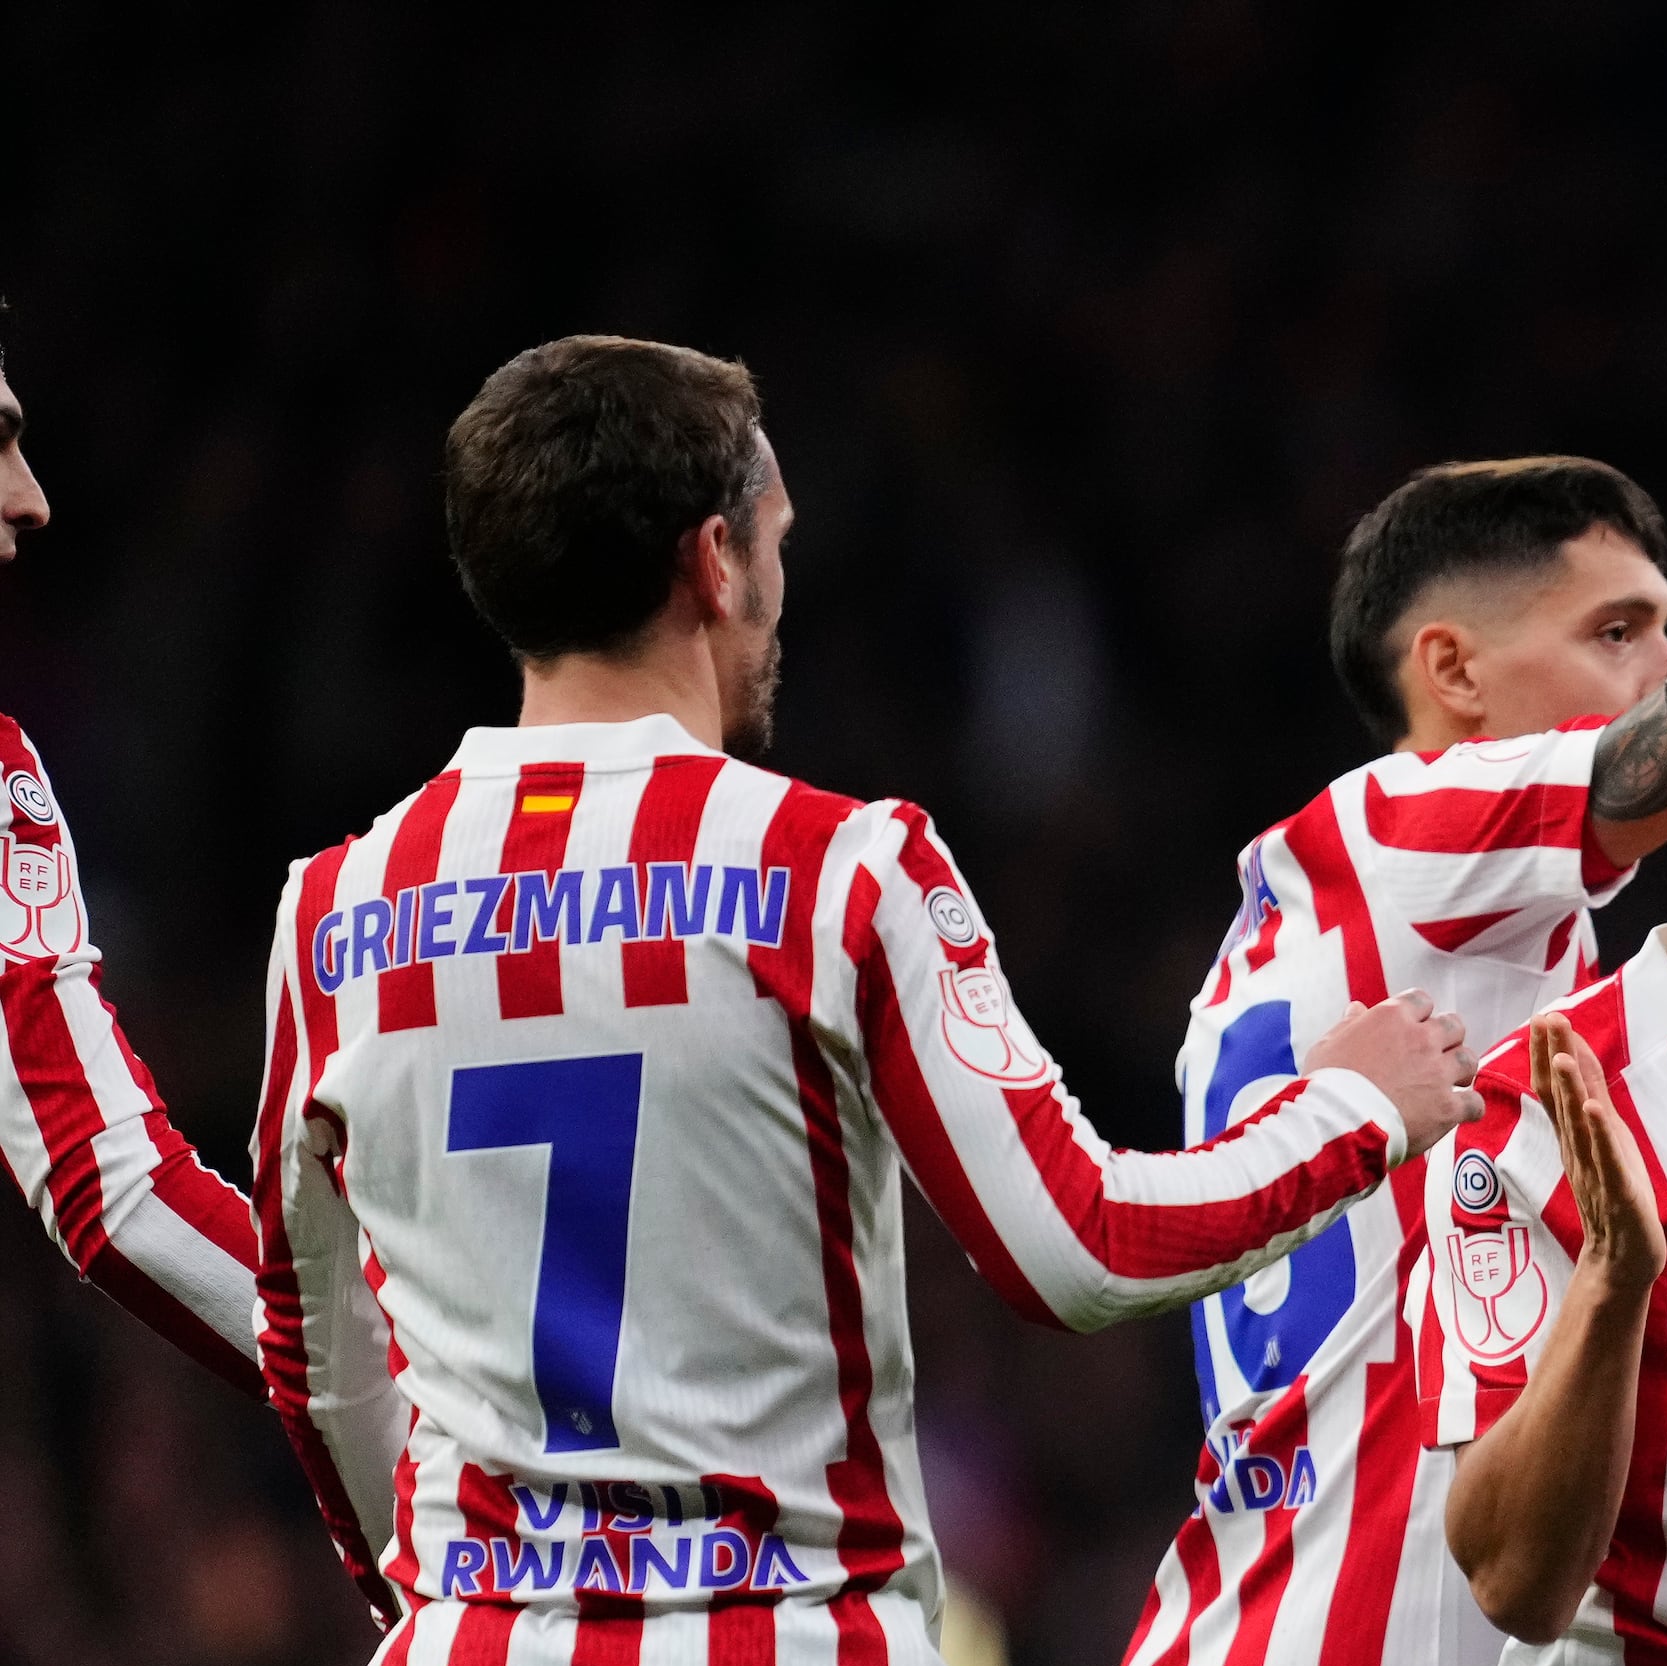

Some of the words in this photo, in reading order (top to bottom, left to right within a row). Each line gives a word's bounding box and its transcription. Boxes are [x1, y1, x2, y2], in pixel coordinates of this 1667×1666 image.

[18, 786, 47, 808] 10
[20, 862, 49, 876] RF
[19, 879, 48, 892] EF
[938, 907, 966, 926] 10
[313, 862, 790, 996] GRIEZMANN
[1462, 1171, 1486, 1191] 10
[444, 1052, 644, 1454] 7
[1471, 1252, 1499, 1266] RF
[1472, 1266, 1501, 1282] EF
[442, 1527, 811, 1598] RWANDA
